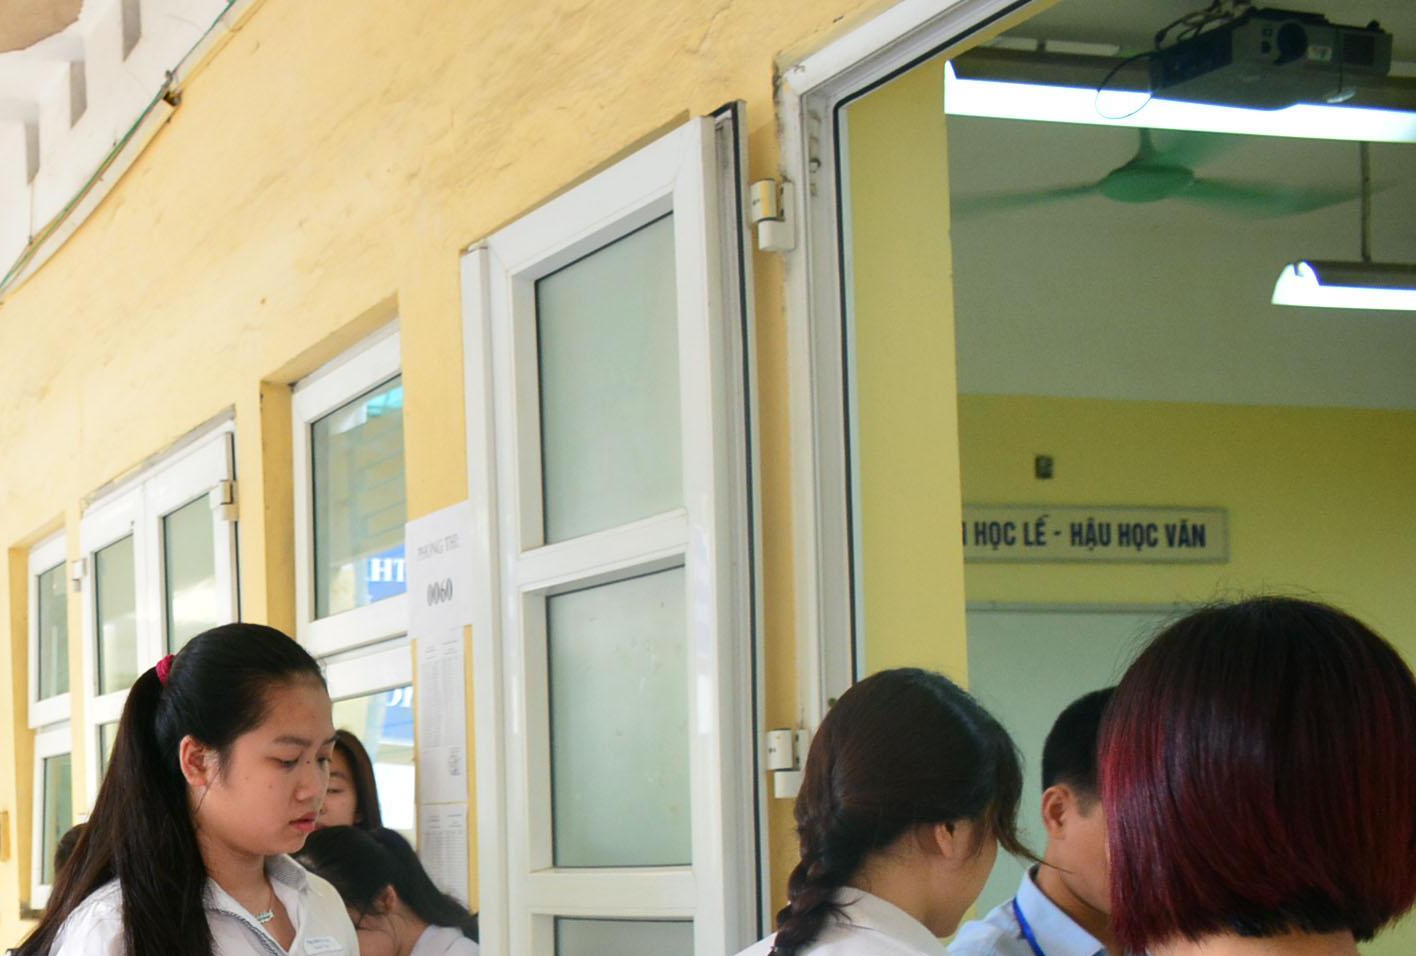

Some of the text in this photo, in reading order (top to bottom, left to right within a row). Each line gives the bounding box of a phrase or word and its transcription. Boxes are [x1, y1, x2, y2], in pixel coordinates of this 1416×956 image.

[974, 521, 1016, 550] HỌC
[1070, 517, 1112, 551] HẬU
[1117, 522, 1158, 551] HỌC
